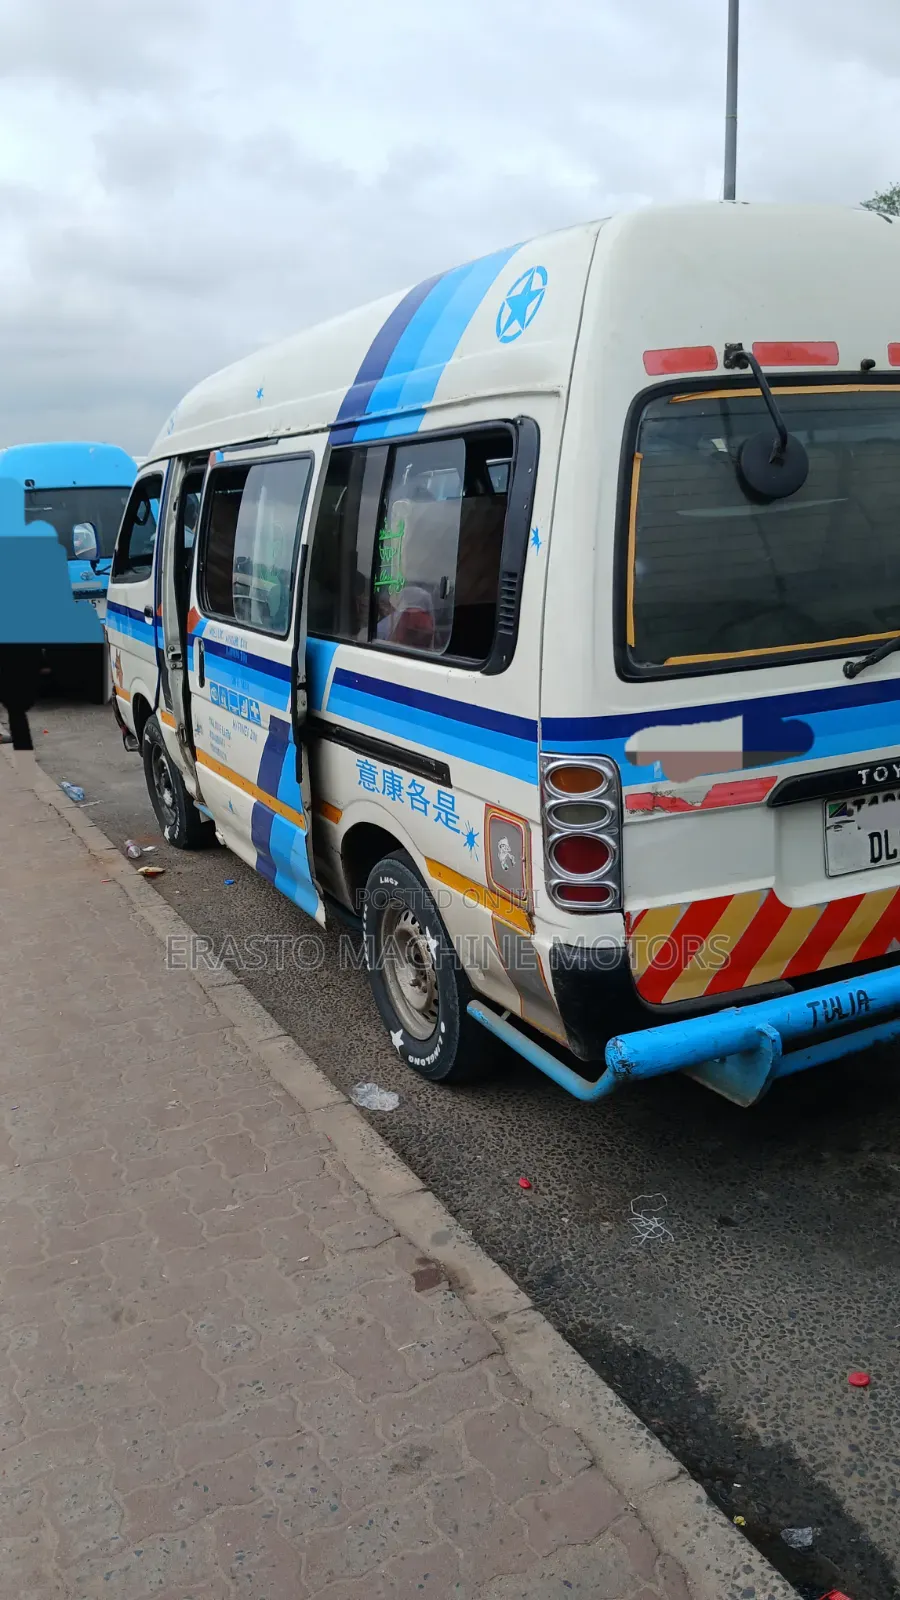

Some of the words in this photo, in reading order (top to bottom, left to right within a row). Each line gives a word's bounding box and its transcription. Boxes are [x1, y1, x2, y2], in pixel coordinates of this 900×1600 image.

[355, 758, 461, 834] 意康各是
[867, 829, 900, 864] DL
[806, 989, 876, 1028] TULIA
